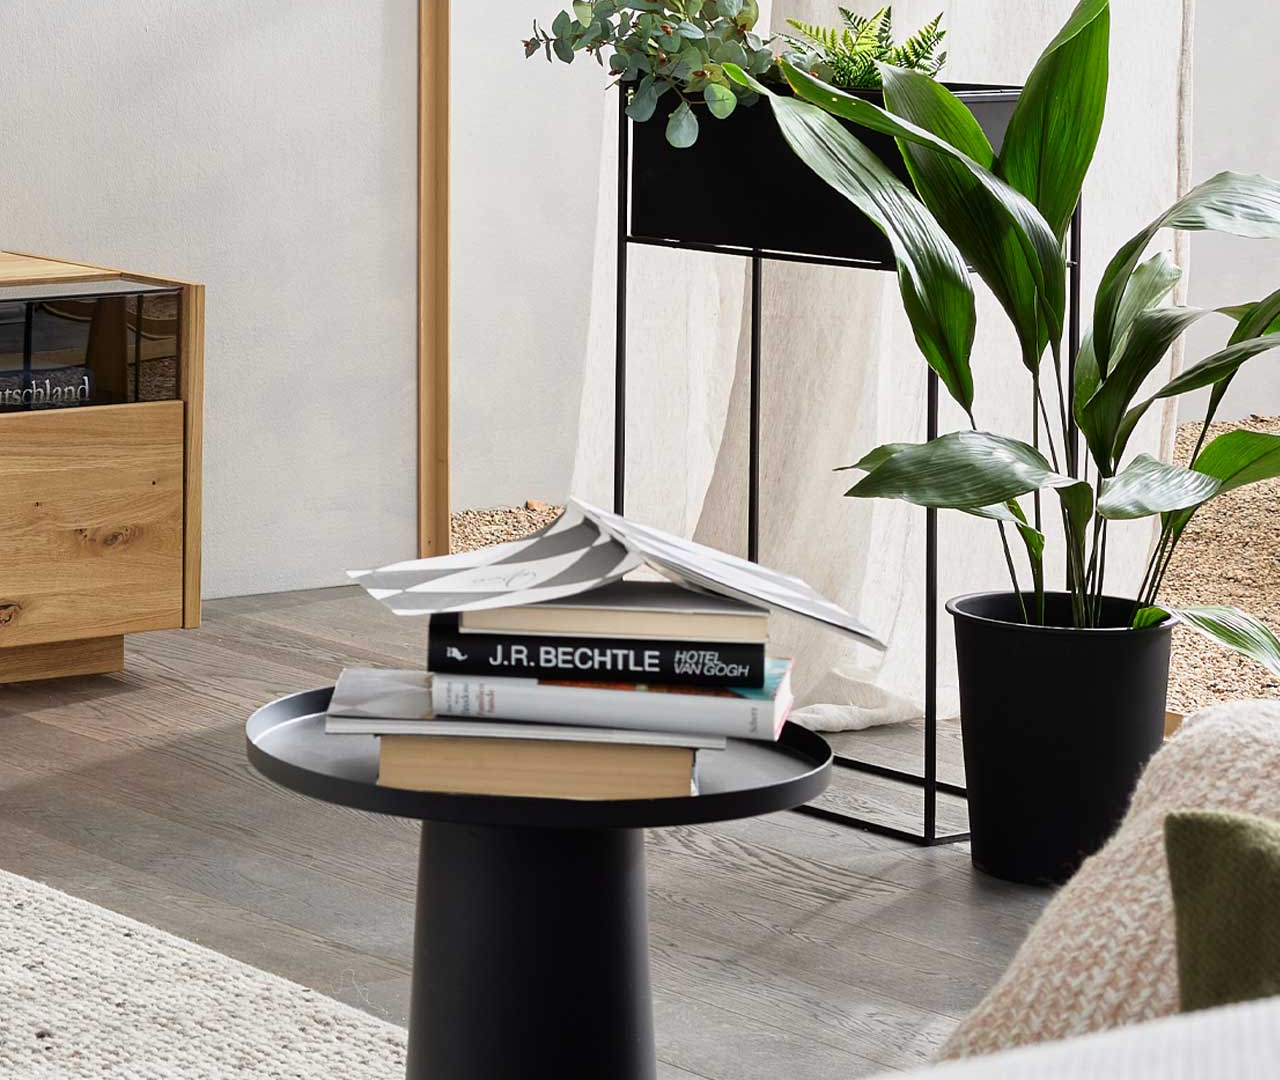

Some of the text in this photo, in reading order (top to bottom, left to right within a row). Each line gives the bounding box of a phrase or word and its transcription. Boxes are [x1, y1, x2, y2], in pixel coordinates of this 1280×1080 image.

[489, 645, 660, 672] J.R. BECHTLE
[674, 650, 721, 664] HOTEL
[673, 662, 750, 677] VAN GOGH
